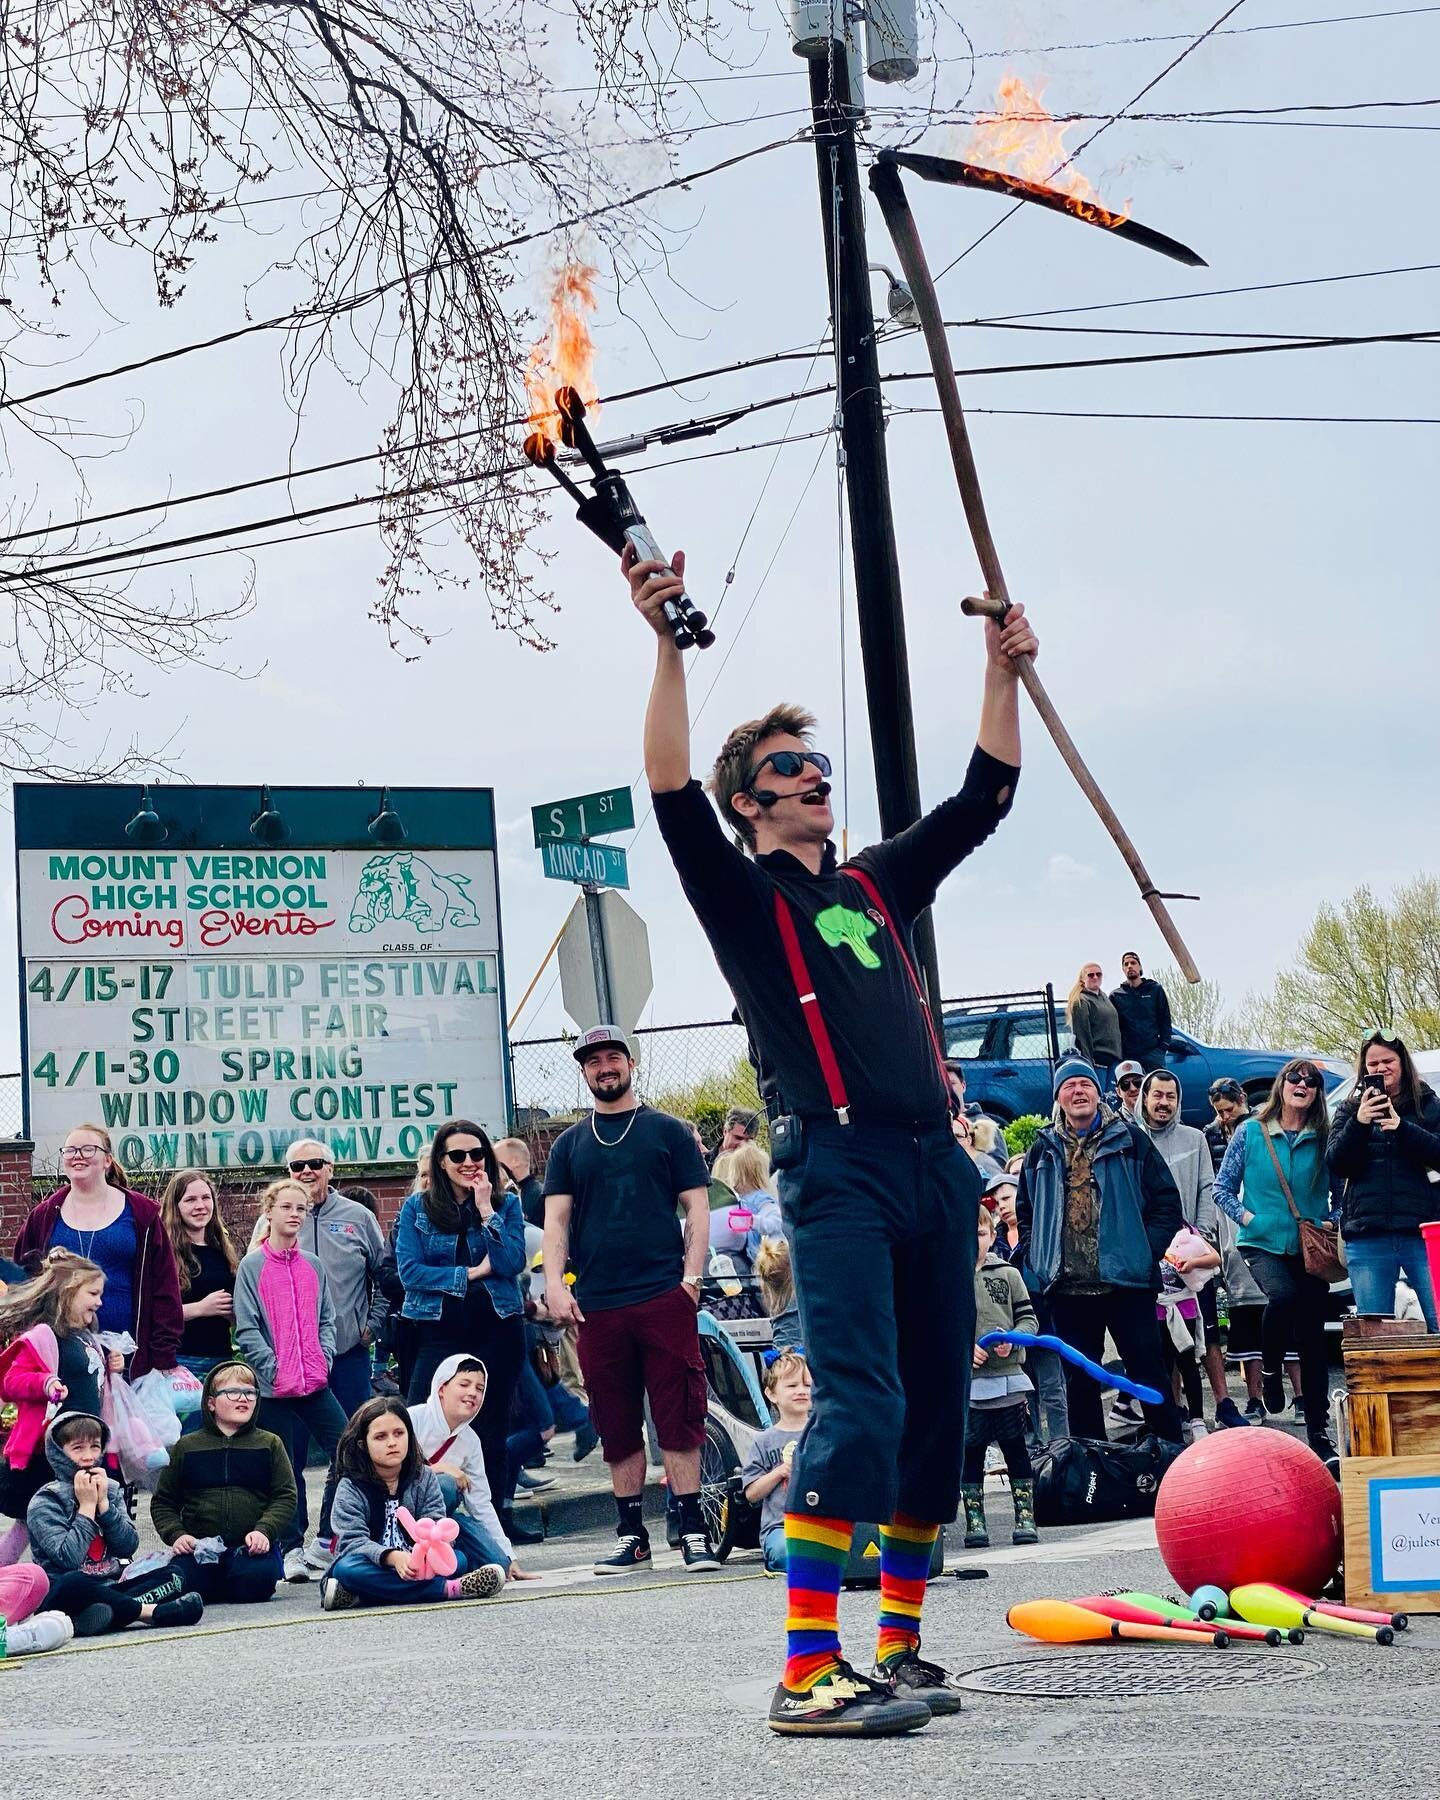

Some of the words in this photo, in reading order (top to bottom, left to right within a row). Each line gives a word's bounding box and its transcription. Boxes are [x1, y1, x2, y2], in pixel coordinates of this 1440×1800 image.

[549, 807, 565, 838] S
[577, 803, 587, 835] 1
[599, 795, 614, 813] ST
[49, 855, 178, 881] MOUNT
[185, 855, 327, 880] VERNON
[547, 842, 607, 881] KINCAID
[612, 851, 622, 867] ST
[92, 885, 178, 910] HIGH
[187, 885, 328, 909] SCHOOL
[51, 894, 184, 948] Coming
[199, 909, 337, 947] Events
[420, 943, 433, 951] OF
[28, 965, 174, 1002] 4/15-17
[193, 963, 305, 1000] TULIP
[320, 961, 497, 998] FESTIVAL
[132, 1005, 284, 1042] STREET
[302, 1004, 390, 1039] FAIR
[32, 1048, 180, 1087] 4/1-30
[221, 1045, 363, 1083] SPRING
[100, 1088, 269, 1128] WINDOW
[289, 1082, 459, 1122] CONTEST
[1085, 1471, 1098, 1504] projekt
